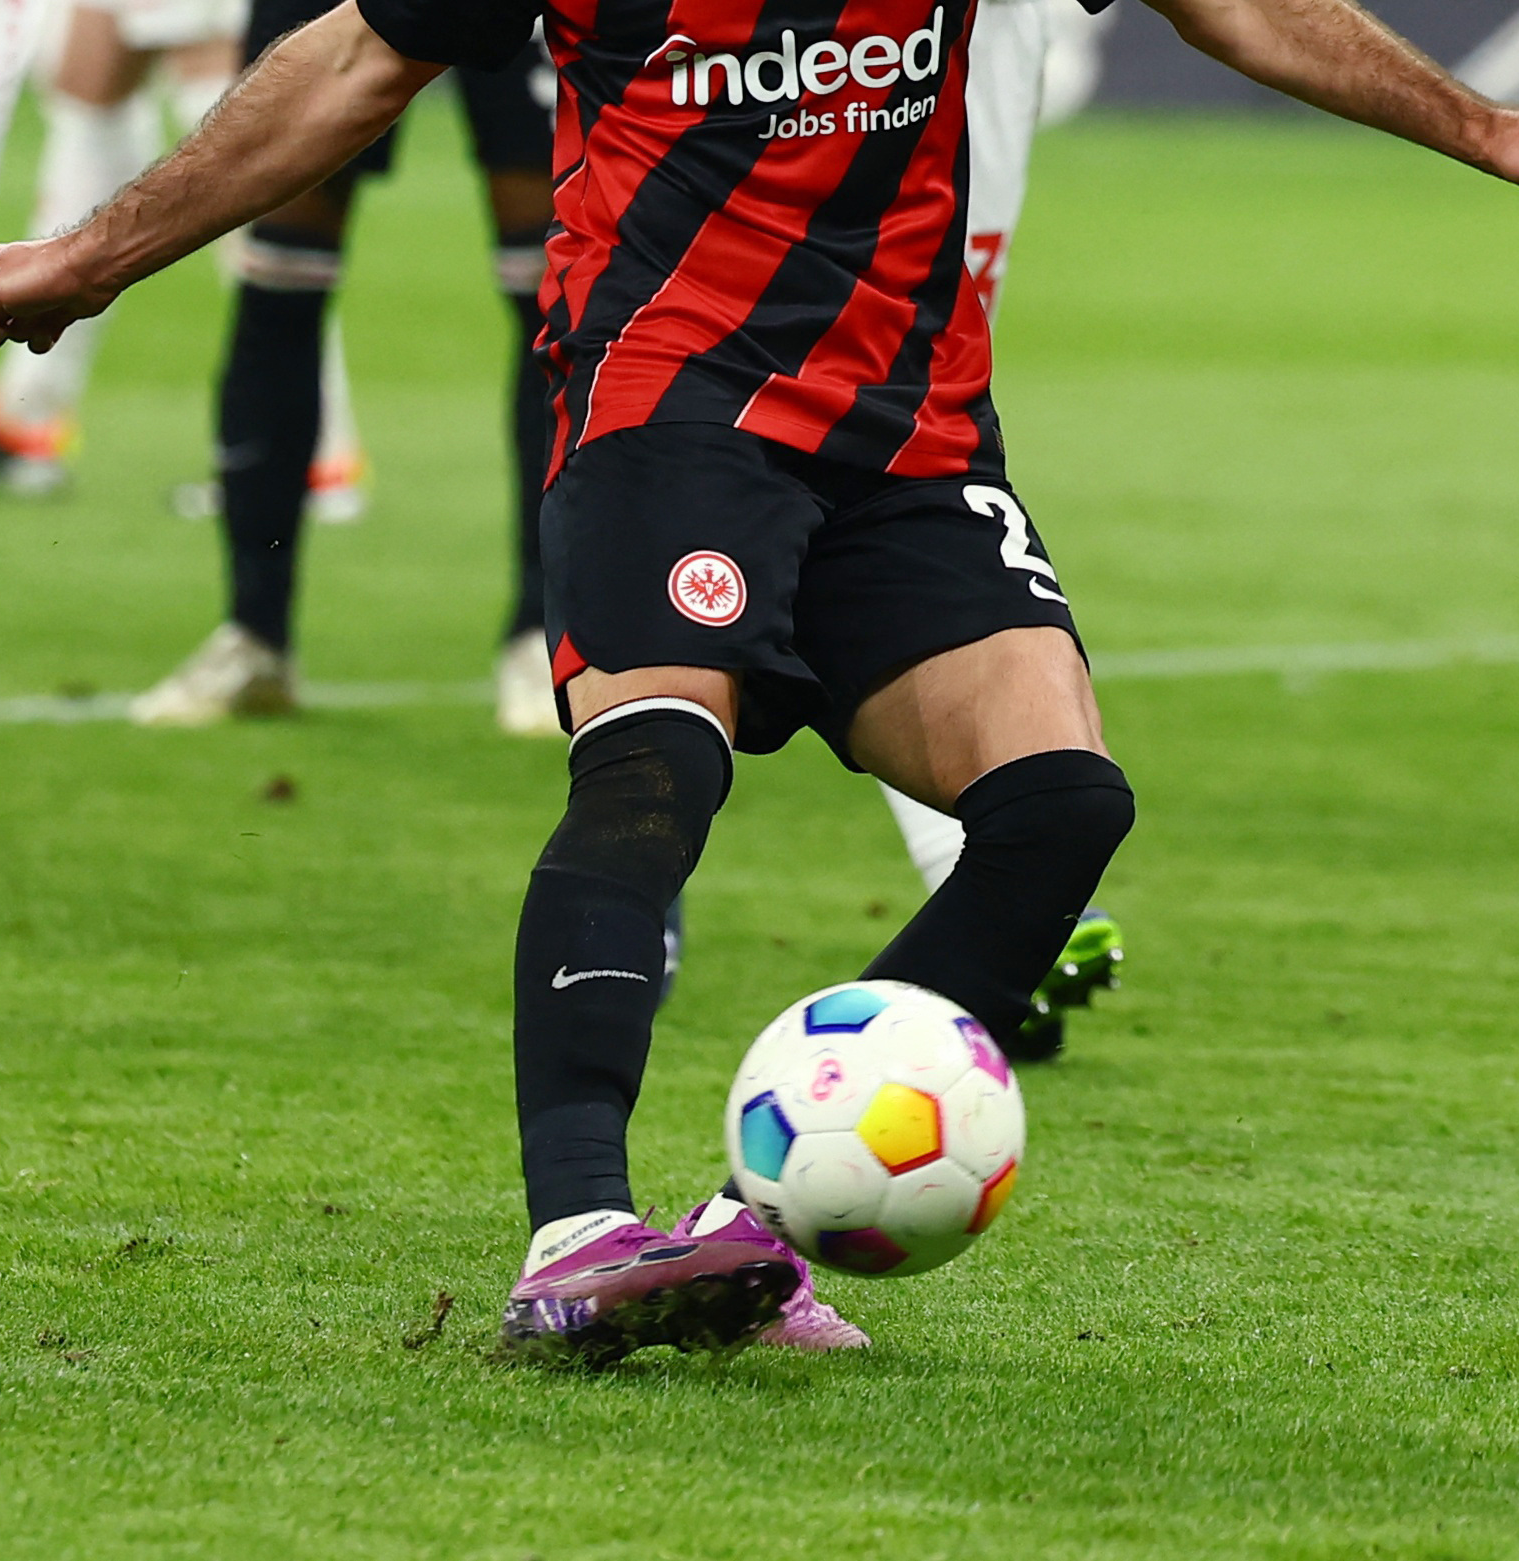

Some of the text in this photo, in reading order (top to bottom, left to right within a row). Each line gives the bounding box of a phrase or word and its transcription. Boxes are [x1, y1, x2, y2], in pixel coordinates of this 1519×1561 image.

[663, 5, 944, 106] indeed
[757, 95, 936, 139] Jobs finden
